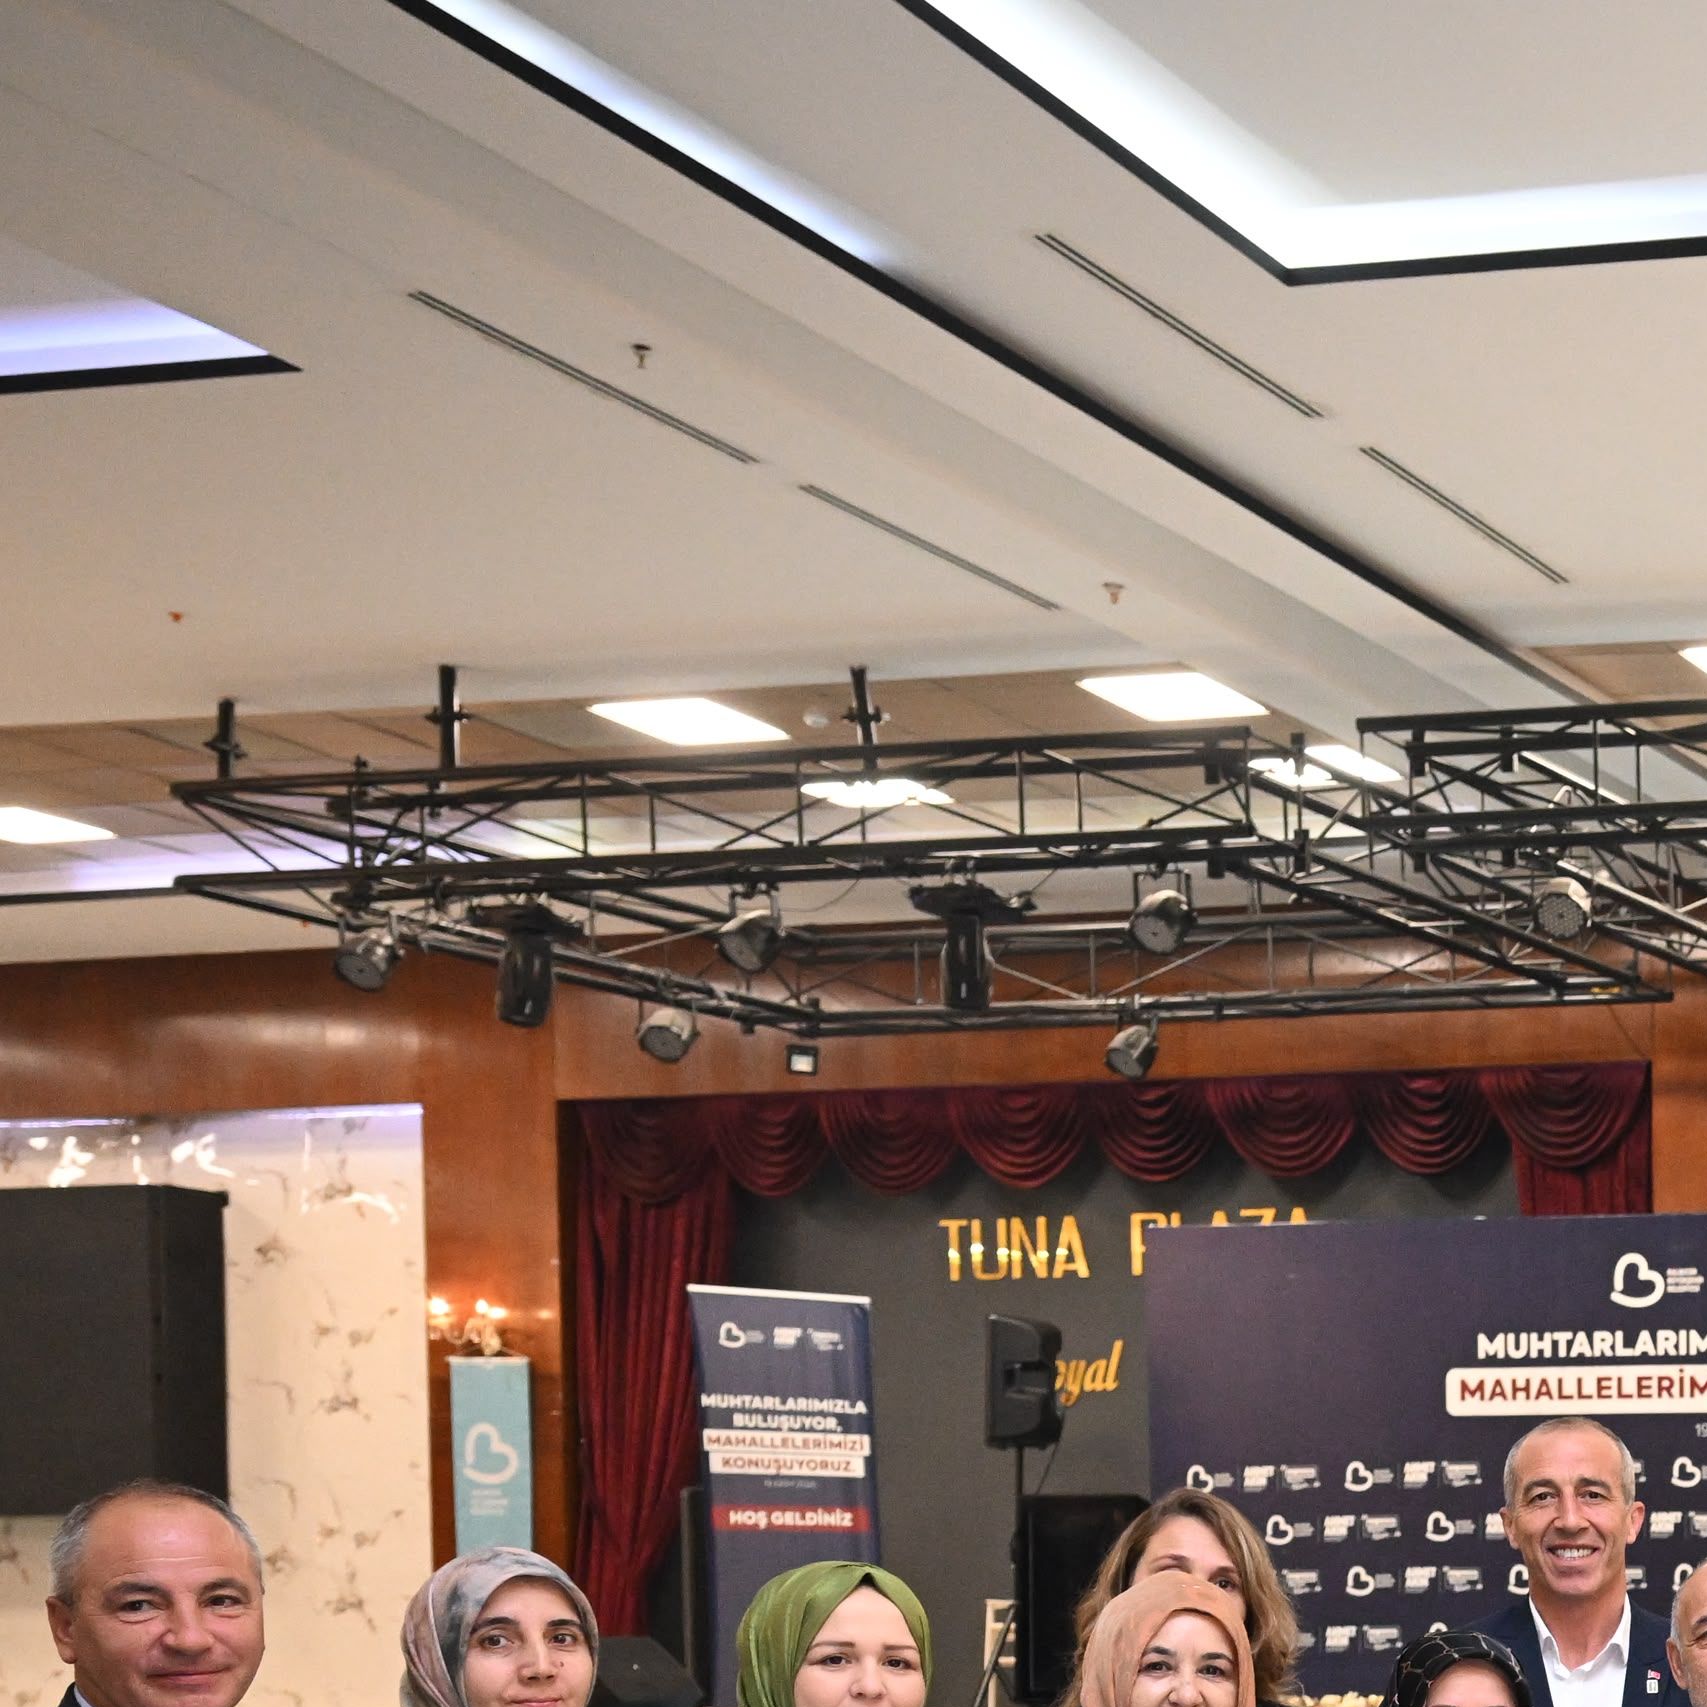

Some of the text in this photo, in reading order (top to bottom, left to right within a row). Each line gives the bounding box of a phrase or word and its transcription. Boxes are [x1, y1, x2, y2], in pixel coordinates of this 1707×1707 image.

[938, 1215, 1091, 1282] TUNA
[700, 1392, 869, 1415] MUHTARLARIMIZLA
[732, 1412, 843, 1433] BULUŞUYOR,
[707, 1434, 865, 1452] MAHALLELERİMİZİ
[721, 1456, 857, 1475] KONUŞUYORUZ.
[728, 1506, 854, 1530] HOŞ GELDİNİZ
